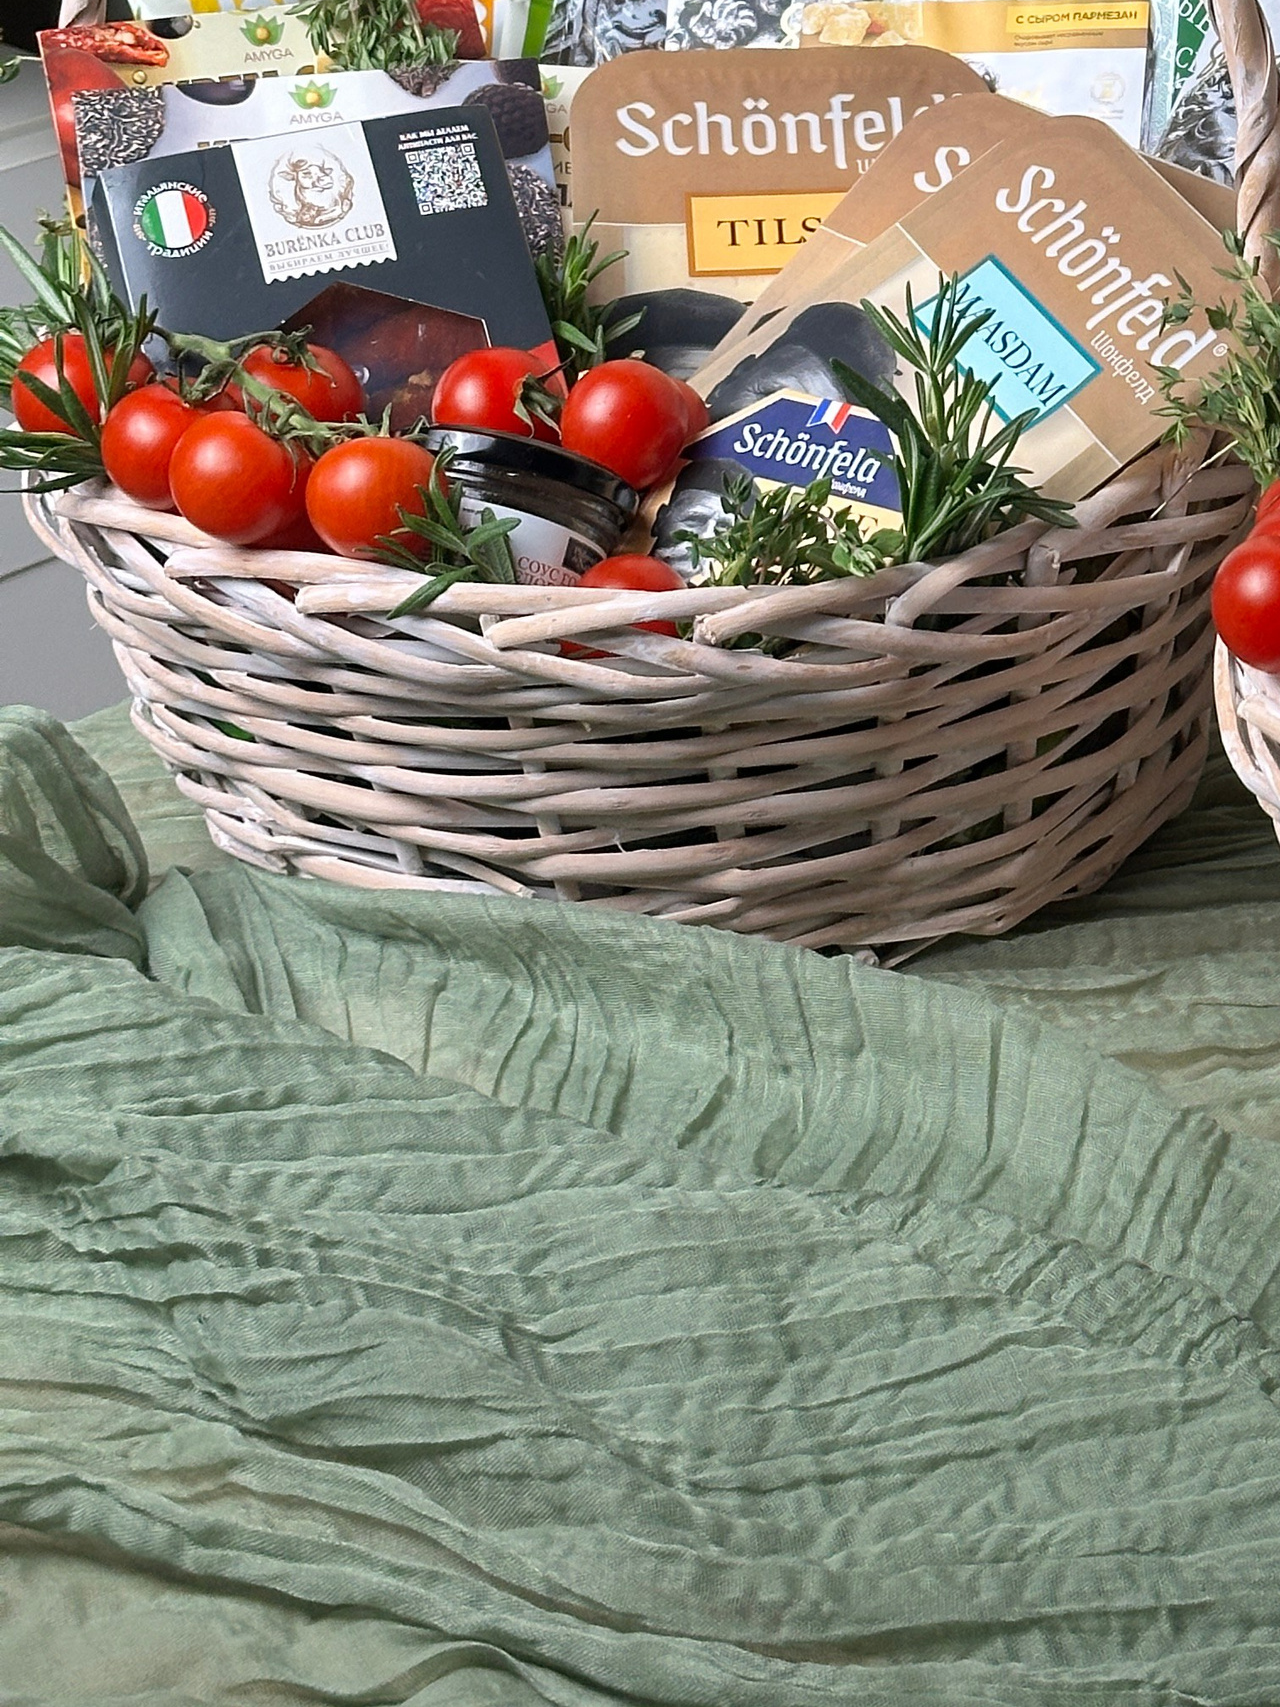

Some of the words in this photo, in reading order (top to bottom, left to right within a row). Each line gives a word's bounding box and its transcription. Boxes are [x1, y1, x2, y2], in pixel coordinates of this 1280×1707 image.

[1027, 12, 1071, 25] СЫРОМ
[1072, 9, 1138, 22] ПАРМЕЗАН
[243, 47, 295, 64] AMYGA
[289, 108, 345, 126] AMYGA
[615, 93, 945, 171] Schönfel
[345, 223, 385, 243] CLUB
[716, 215, 823, 247] TILS
[995, 163, 1219, 371] Schönfeld
[1090, 328, 1156, 405] Шонфелд
[518, 556, 560, 582] СОУС
